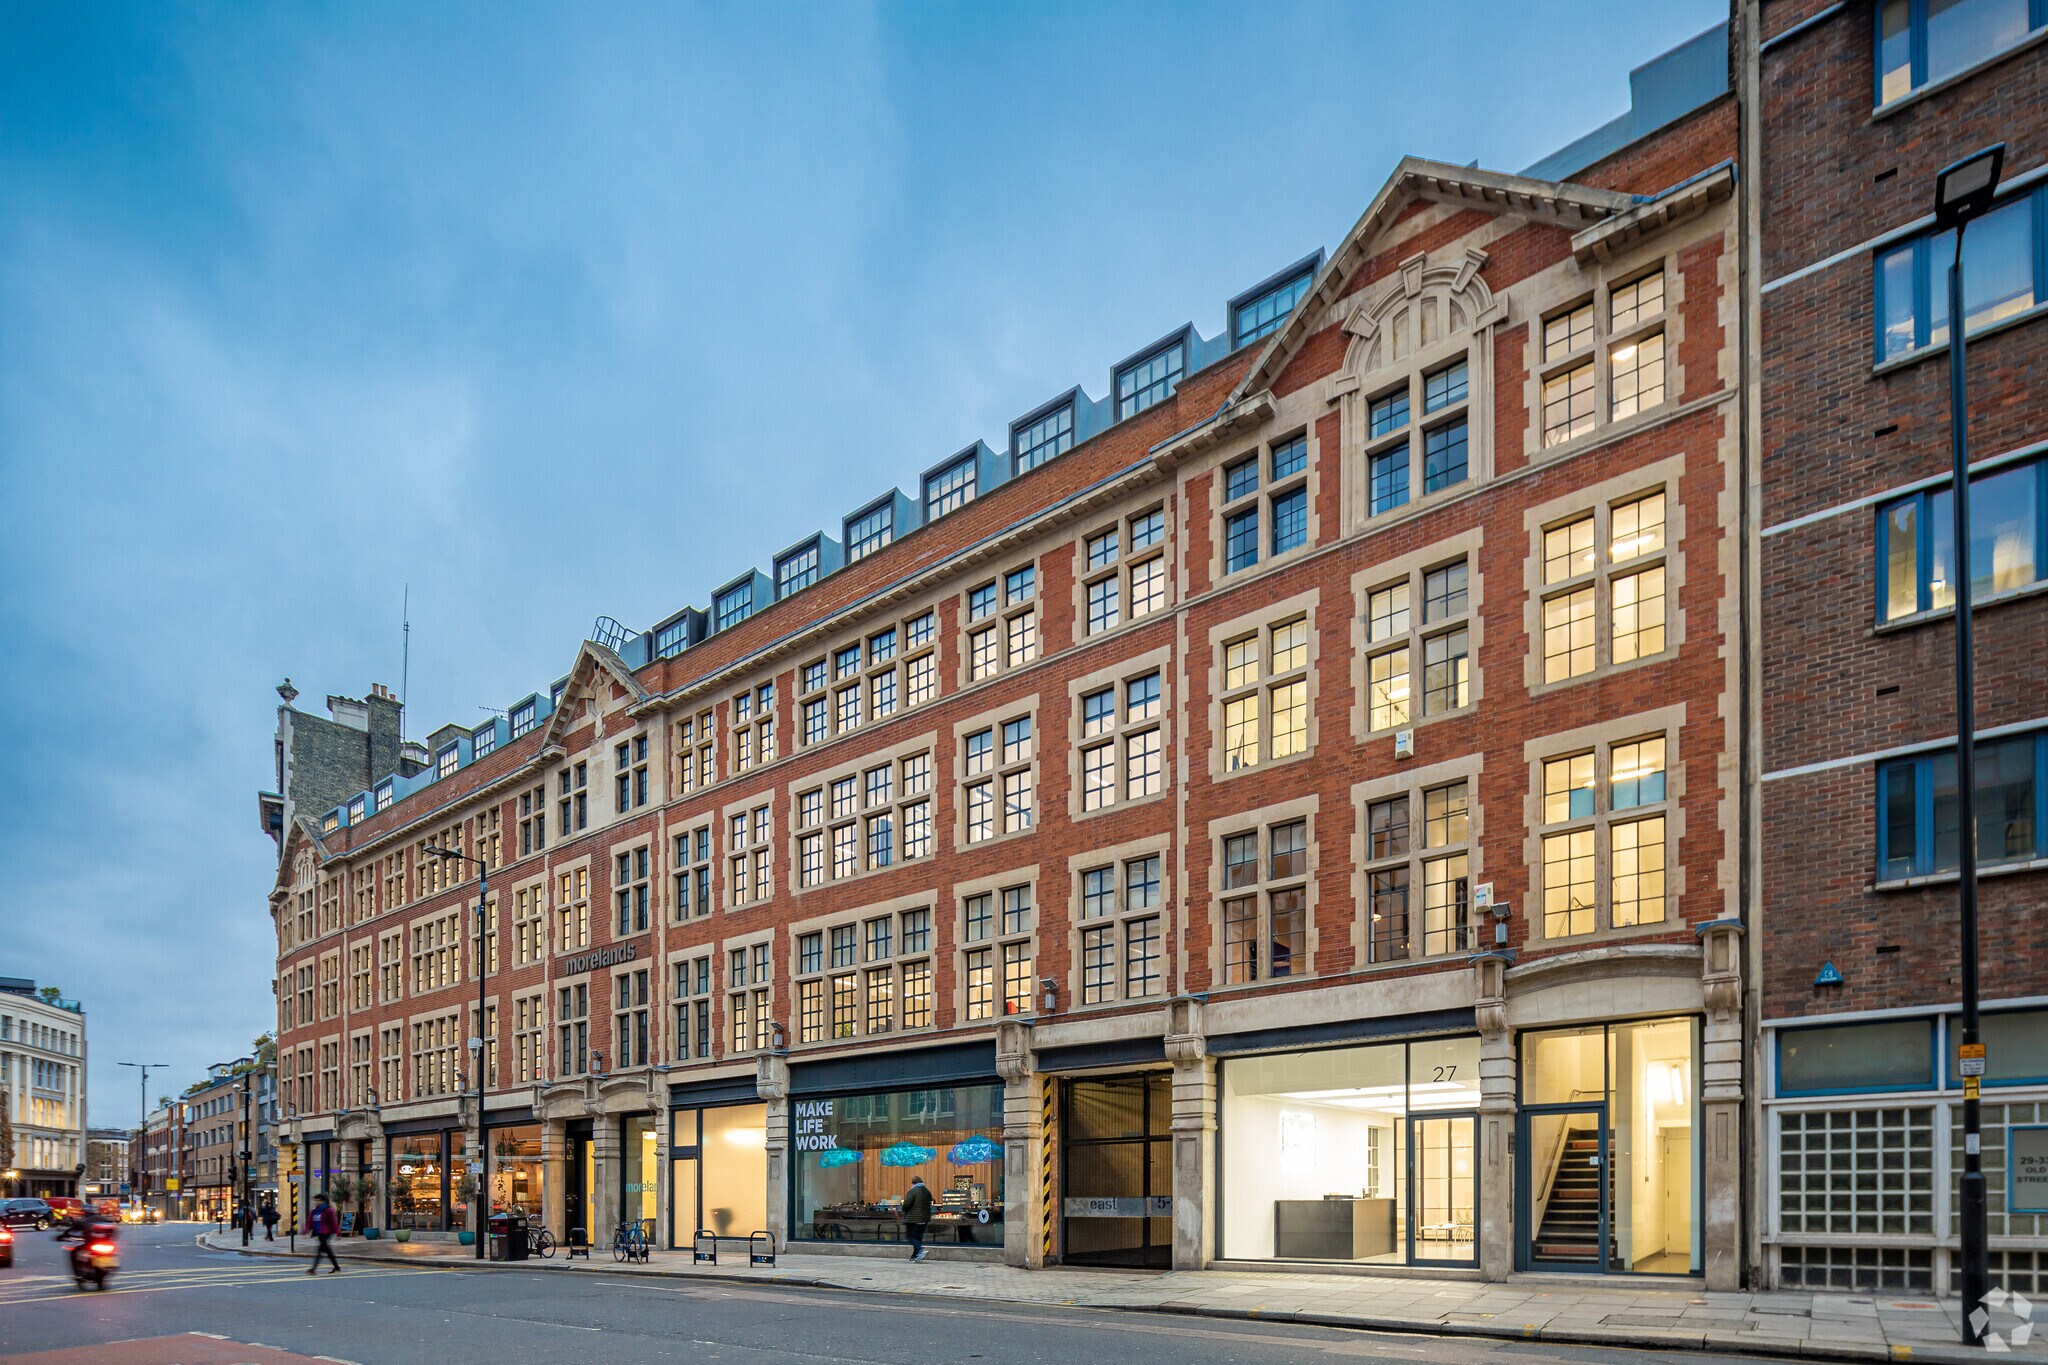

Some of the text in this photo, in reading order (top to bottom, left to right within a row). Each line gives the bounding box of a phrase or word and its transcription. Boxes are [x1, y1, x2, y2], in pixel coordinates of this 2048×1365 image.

[565, 941, 636, 976] morelands
[1433, 1065, 1457, 1082] 27
[795, 1101, 833, 1117] MAKE
[795, 1119, 823, 1134] LIFE
[795, 1135, 838, 1150] WORK
[1089, 1196, 1173, 1210] east 5-
